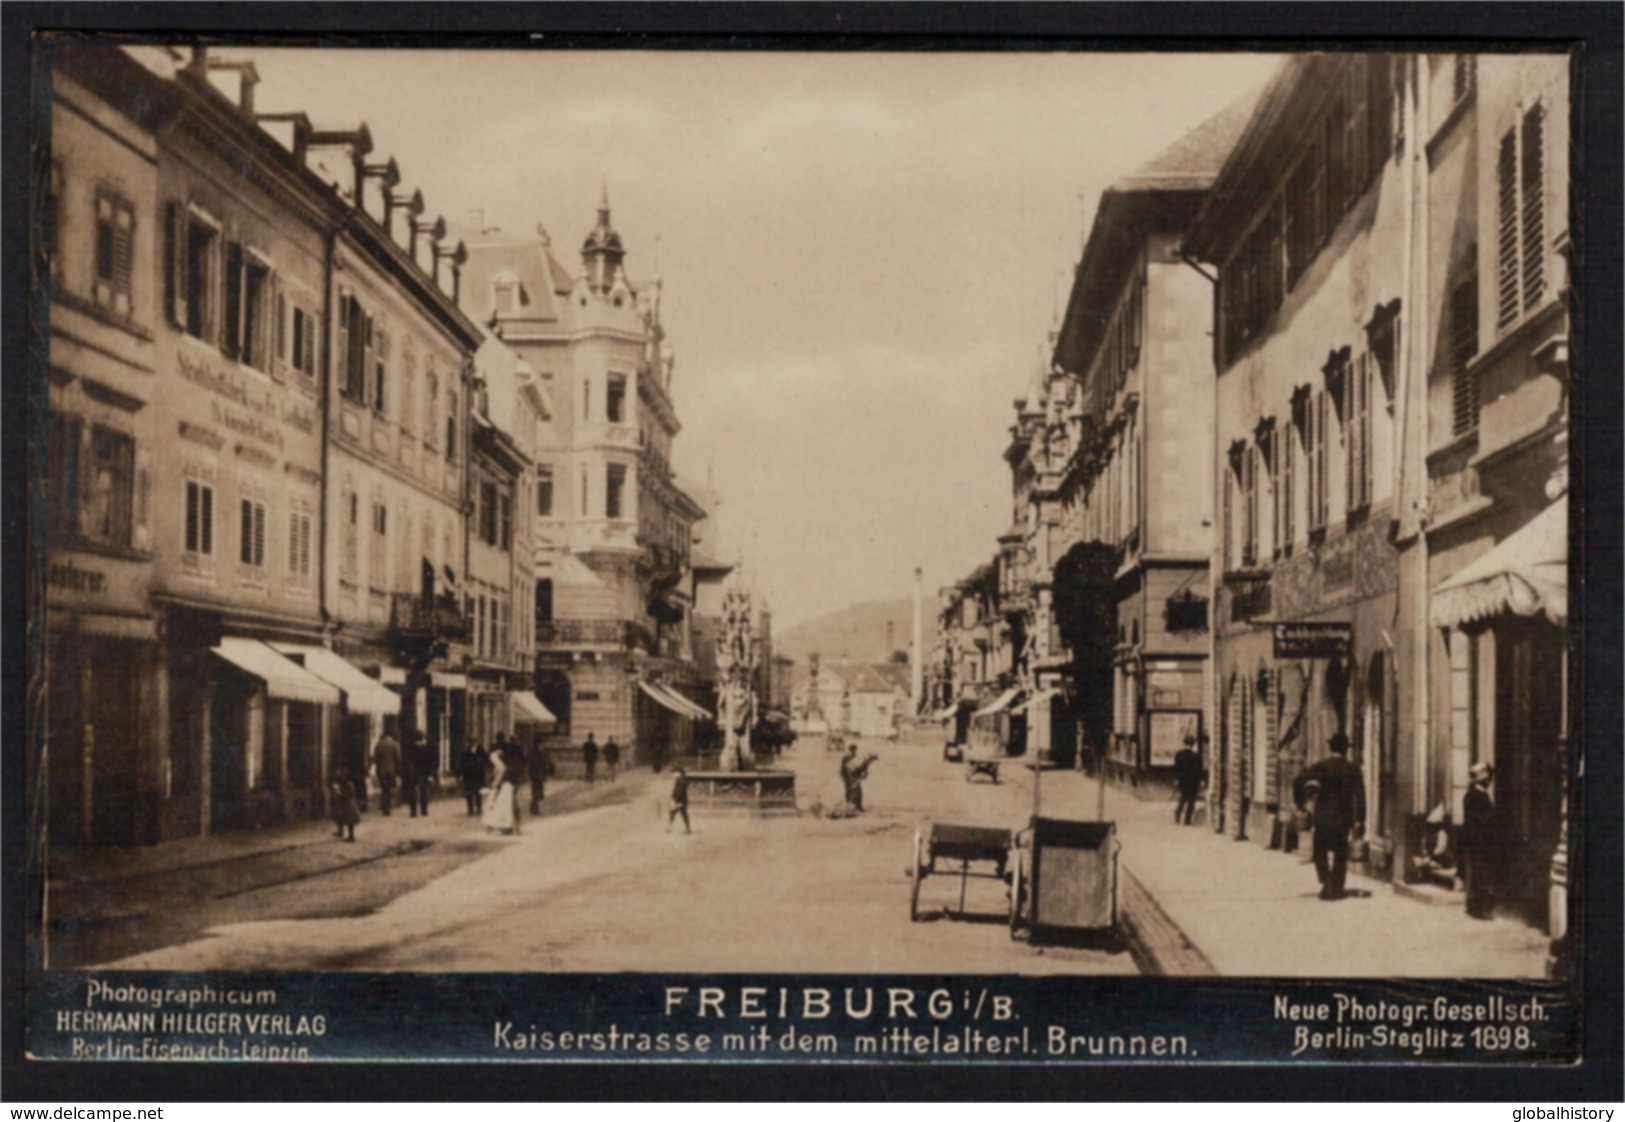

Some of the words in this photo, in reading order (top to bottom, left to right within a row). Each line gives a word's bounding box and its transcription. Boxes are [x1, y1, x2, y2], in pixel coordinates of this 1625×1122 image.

[88, 980, 276, 1008] Photographicum
[665, 987, 952, 1019] FREIBURG
[56, 1010, 155, 1032] HERMANN
[162, 1012, 241, 1035] HILLGER
[245, 1014, 326, 1036] VERLAG
[1274, 996, 1329, 1020] Neue
[1334, 993, 1429, 1027] Photogr.
[1434, 996, 1549, 1021] Gesellsch.
[494, 1021, 711, 1053] Kaiserstrasse
[723, 1025, 770, 1052] mit
[779, 1025, 838, 1053] dem
[854, 1026, 1037, 1054] mittelalterl.
[1048, 1025, 1197, 1056] Brunnen.
[1292, 1025, 1464, 1055] Berlin-Steglitz
[1471, 1026, 1536, 1050] 1898.
